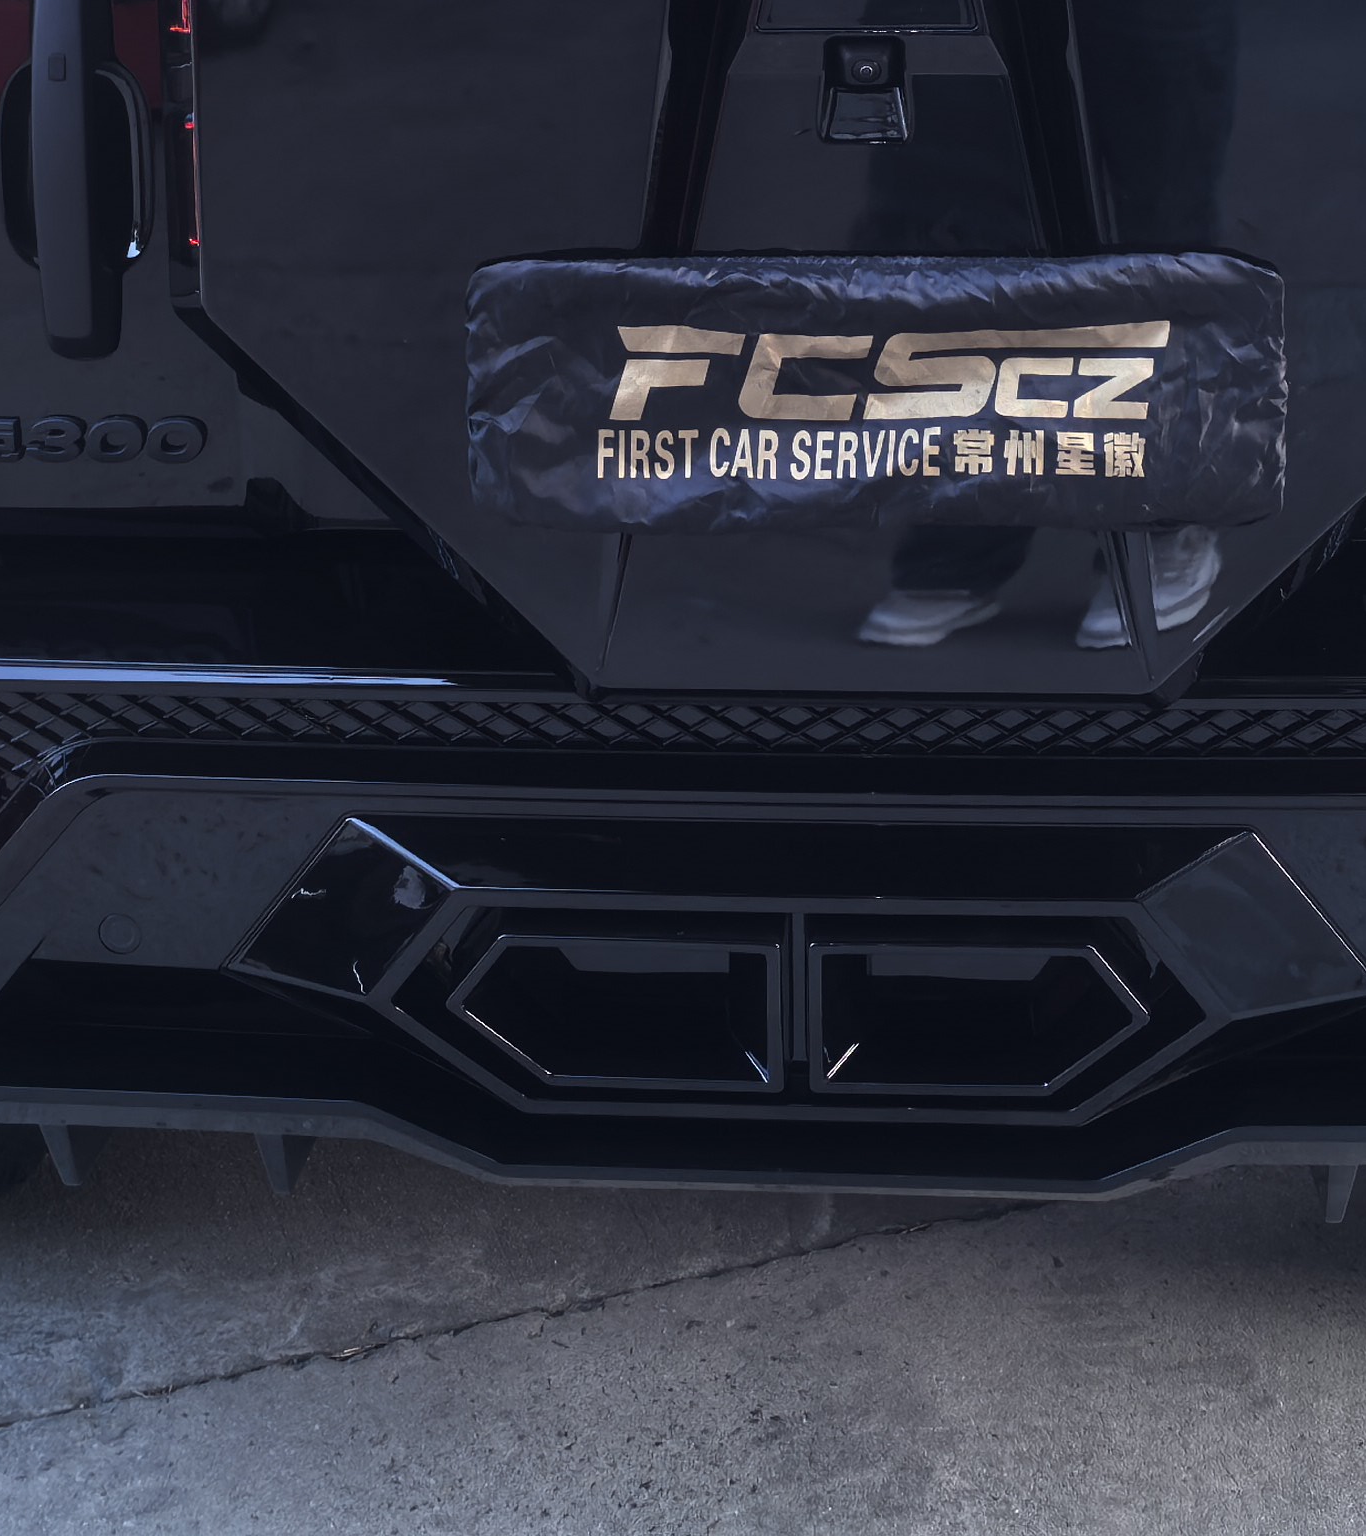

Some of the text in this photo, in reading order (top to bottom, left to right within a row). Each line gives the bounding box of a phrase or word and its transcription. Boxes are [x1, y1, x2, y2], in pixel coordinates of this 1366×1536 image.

[596, 426, 1147, 481] FIRST CAR SERVICE 常州星徽
